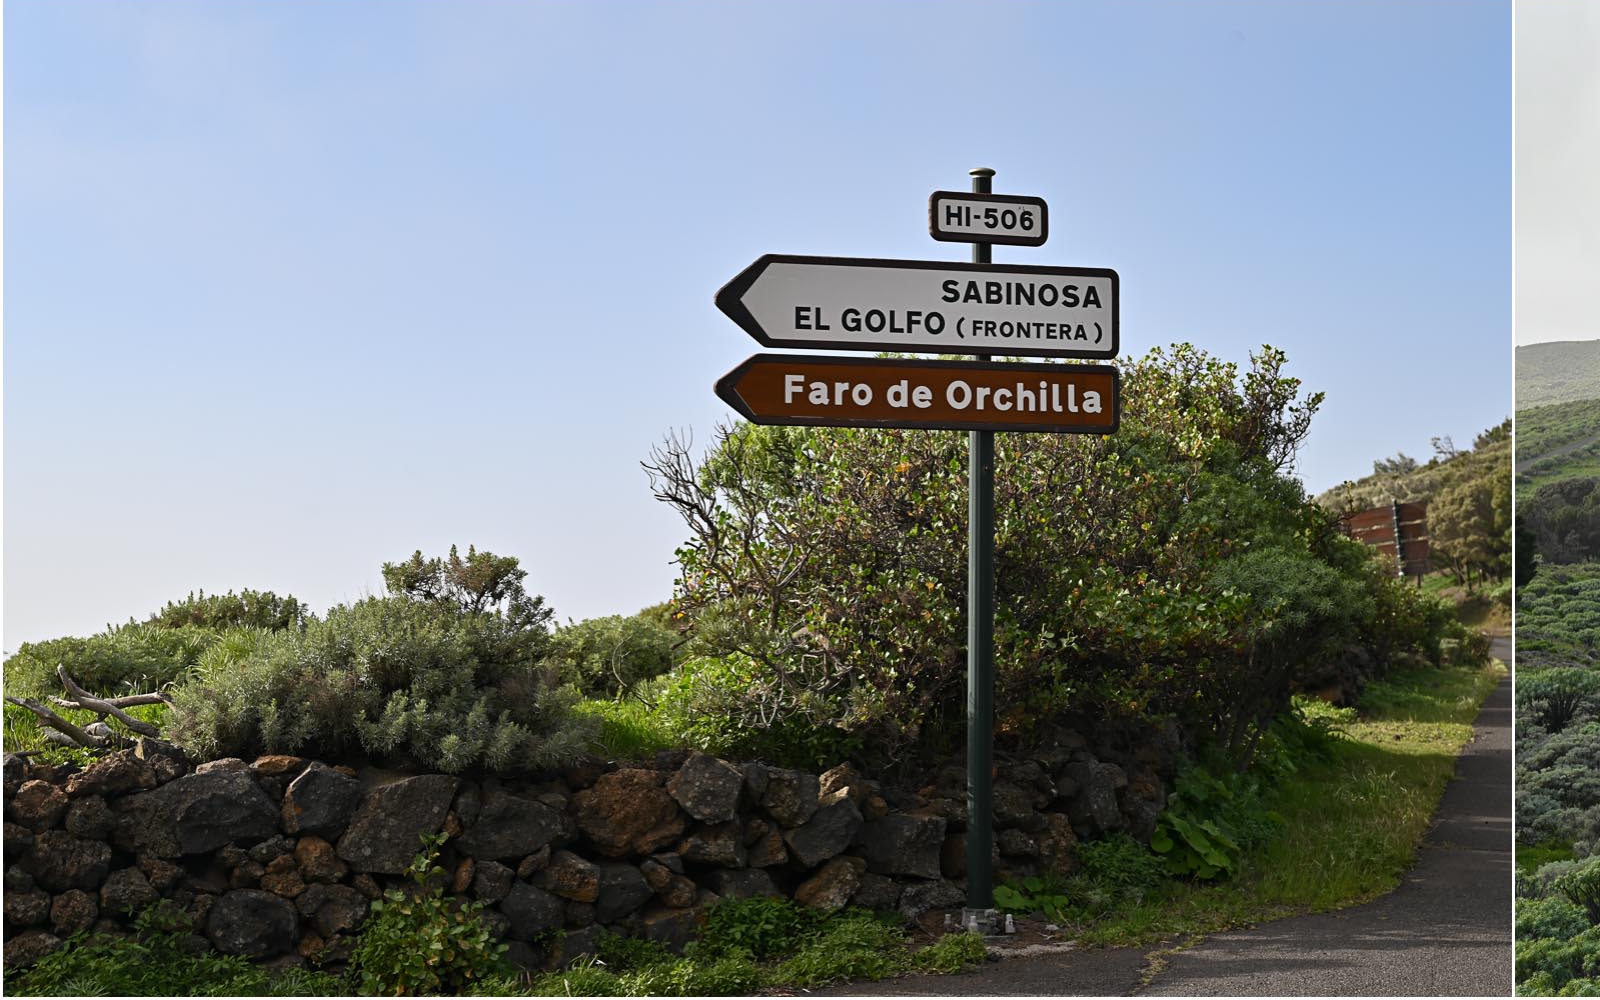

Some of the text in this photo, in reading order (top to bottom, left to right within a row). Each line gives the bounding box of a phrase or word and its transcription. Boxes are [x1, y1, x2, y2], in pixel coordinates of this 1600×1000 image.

[945, 205, 1034, 232] HI-506
[941, 279, 1103, 309] SABINOSA
[795, 306, 830, 331] EL
[841, 308, 946, 335] GOLFO
[784, 374, 1103, 414] Faro de Orchilla
